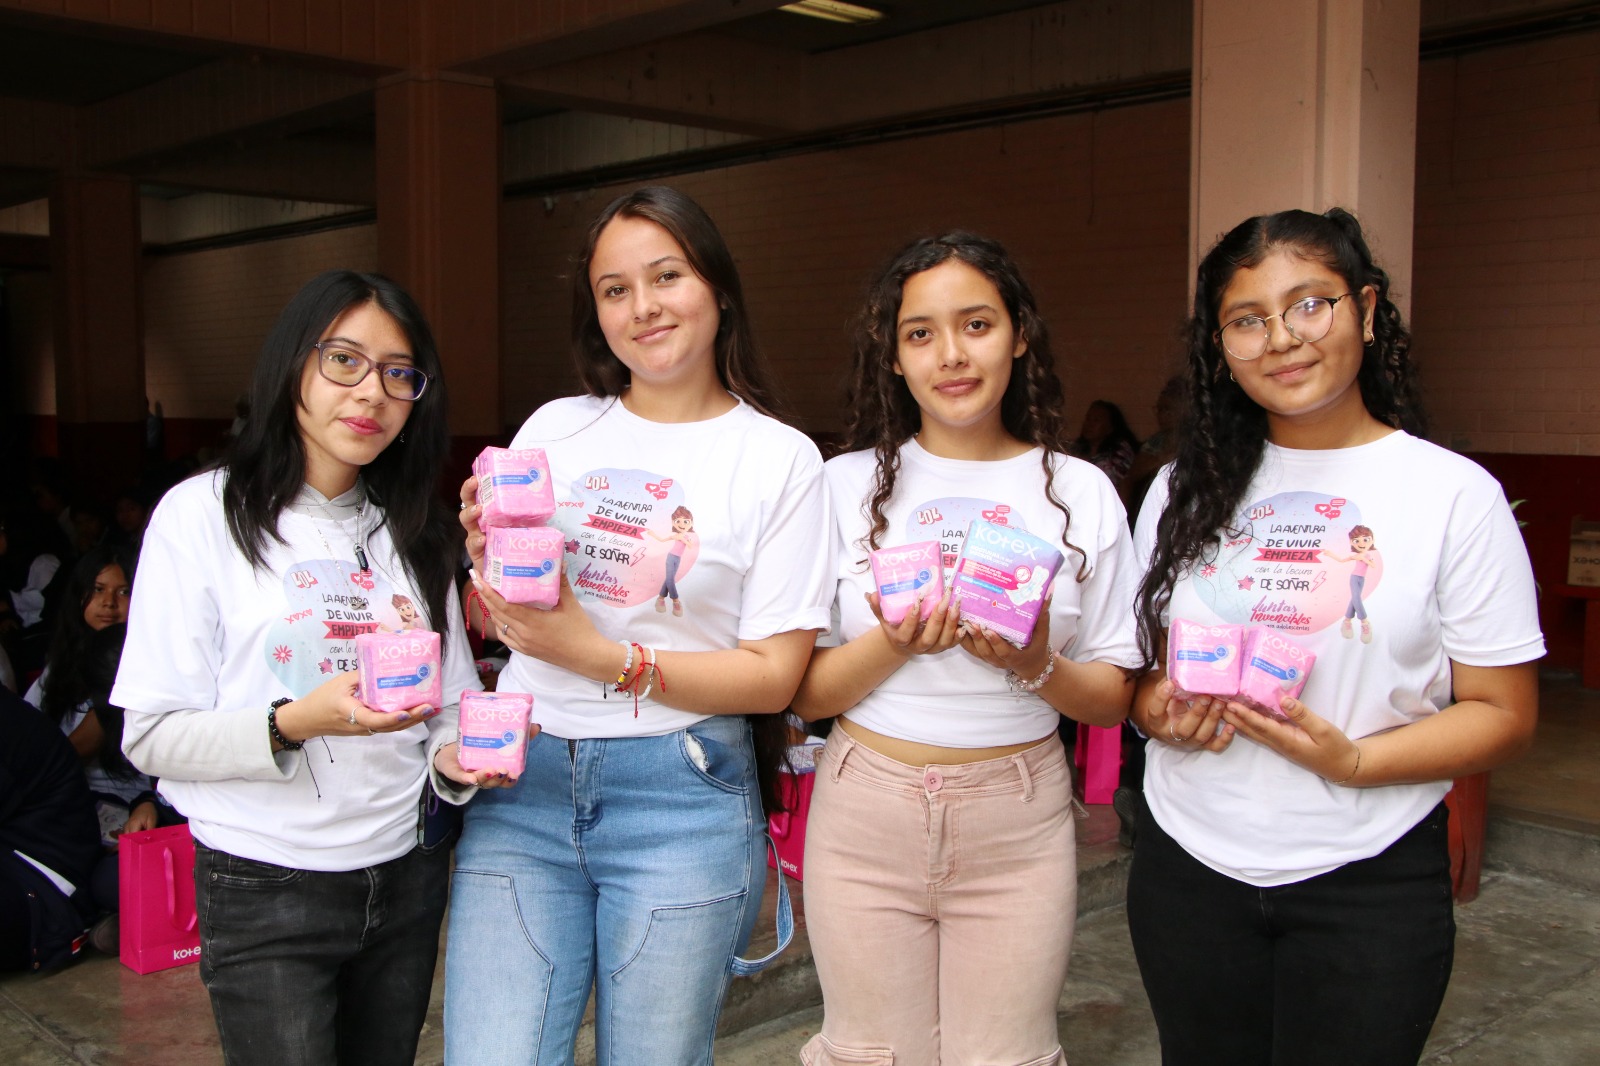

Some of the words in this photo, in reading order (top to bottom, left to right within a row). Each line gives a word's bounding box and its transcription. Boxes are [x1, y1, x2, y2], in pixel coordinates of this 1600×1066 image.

[585, 476, 609, 490] LOL
[602, 497, 613, 506] LA
[614, 501, 653, 513] AVENTURA
[1250, 504, 1275, 520] LOL
[595, 505, 614, 517] DE
[615, 512, 648, 526] VIVIR
[916, 507, 943, 525] LOL
[591, 518, 637, 536] EMPIEZA
[942, 529, 954, 538] LA
[1270, 524, 1283, 533] LA
[1284, 524, 1326, 534] AVENTURA
[580, 531, 595, 539] con
[941, 543, 958, 553] DE
[1266, 539, 1285, 547] DE
[1287, 539, 1322, 548] VIVIR
[585, 545, 597, 558] DE
[600, 548, 630, 565] SOÑAR
[1263, 551, 1313, 561] EMPIEZA
[578, 562, 618, 585] Juntas
[1254, 566, 1270, 574] con
[1286, 564, 1312, 575] locura
[291, 571, 318, 588] LOL
[574, 575, 630, 598] Invencibles
[1260, 579, 1272, 591] DE
[1276, 577, 1310, 591] SOÑAR
[955, 586, 961, 594] 8
[322, 593, 334, 603] LA
[1251, 595, 1298, 613] Juntas
[326, 609, 342, 620] DE
[344, 610, 374, 621] VIVIR
[1249, 610, 1312, 625] Invencibles
[331, 624, 373, 637] EMPIEZA
[337, 659, 349, 672] DE
[173, 946, 202, 960] kote
